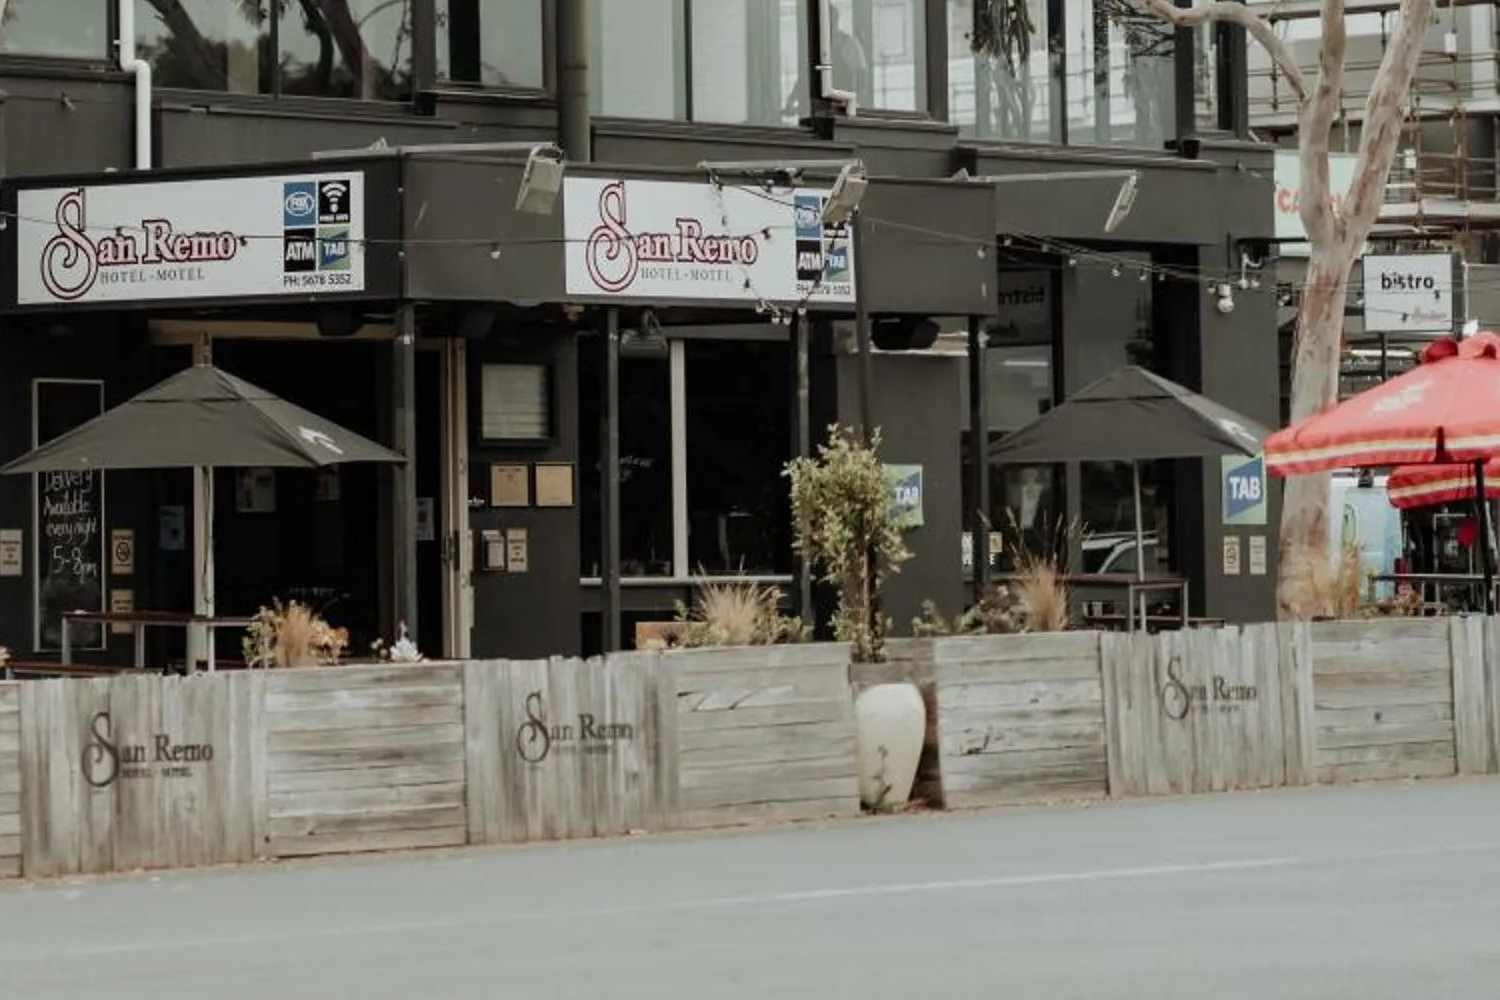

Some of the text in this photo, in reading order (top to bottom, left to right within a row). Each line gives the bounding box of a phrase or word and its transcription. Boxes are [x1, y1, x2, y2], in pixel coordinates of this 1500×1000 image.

[41, 187, 237, 300] San Remo
[586, 181, 758, 292] San Remo
[285, 241, 315, 261] ATM
[323, 241, 346, 257] TAB
[1380, 272, 1435, 290] bistro
[1228, 476, 1260, 499] TAB
[154, 734, 214, 763] Remo
